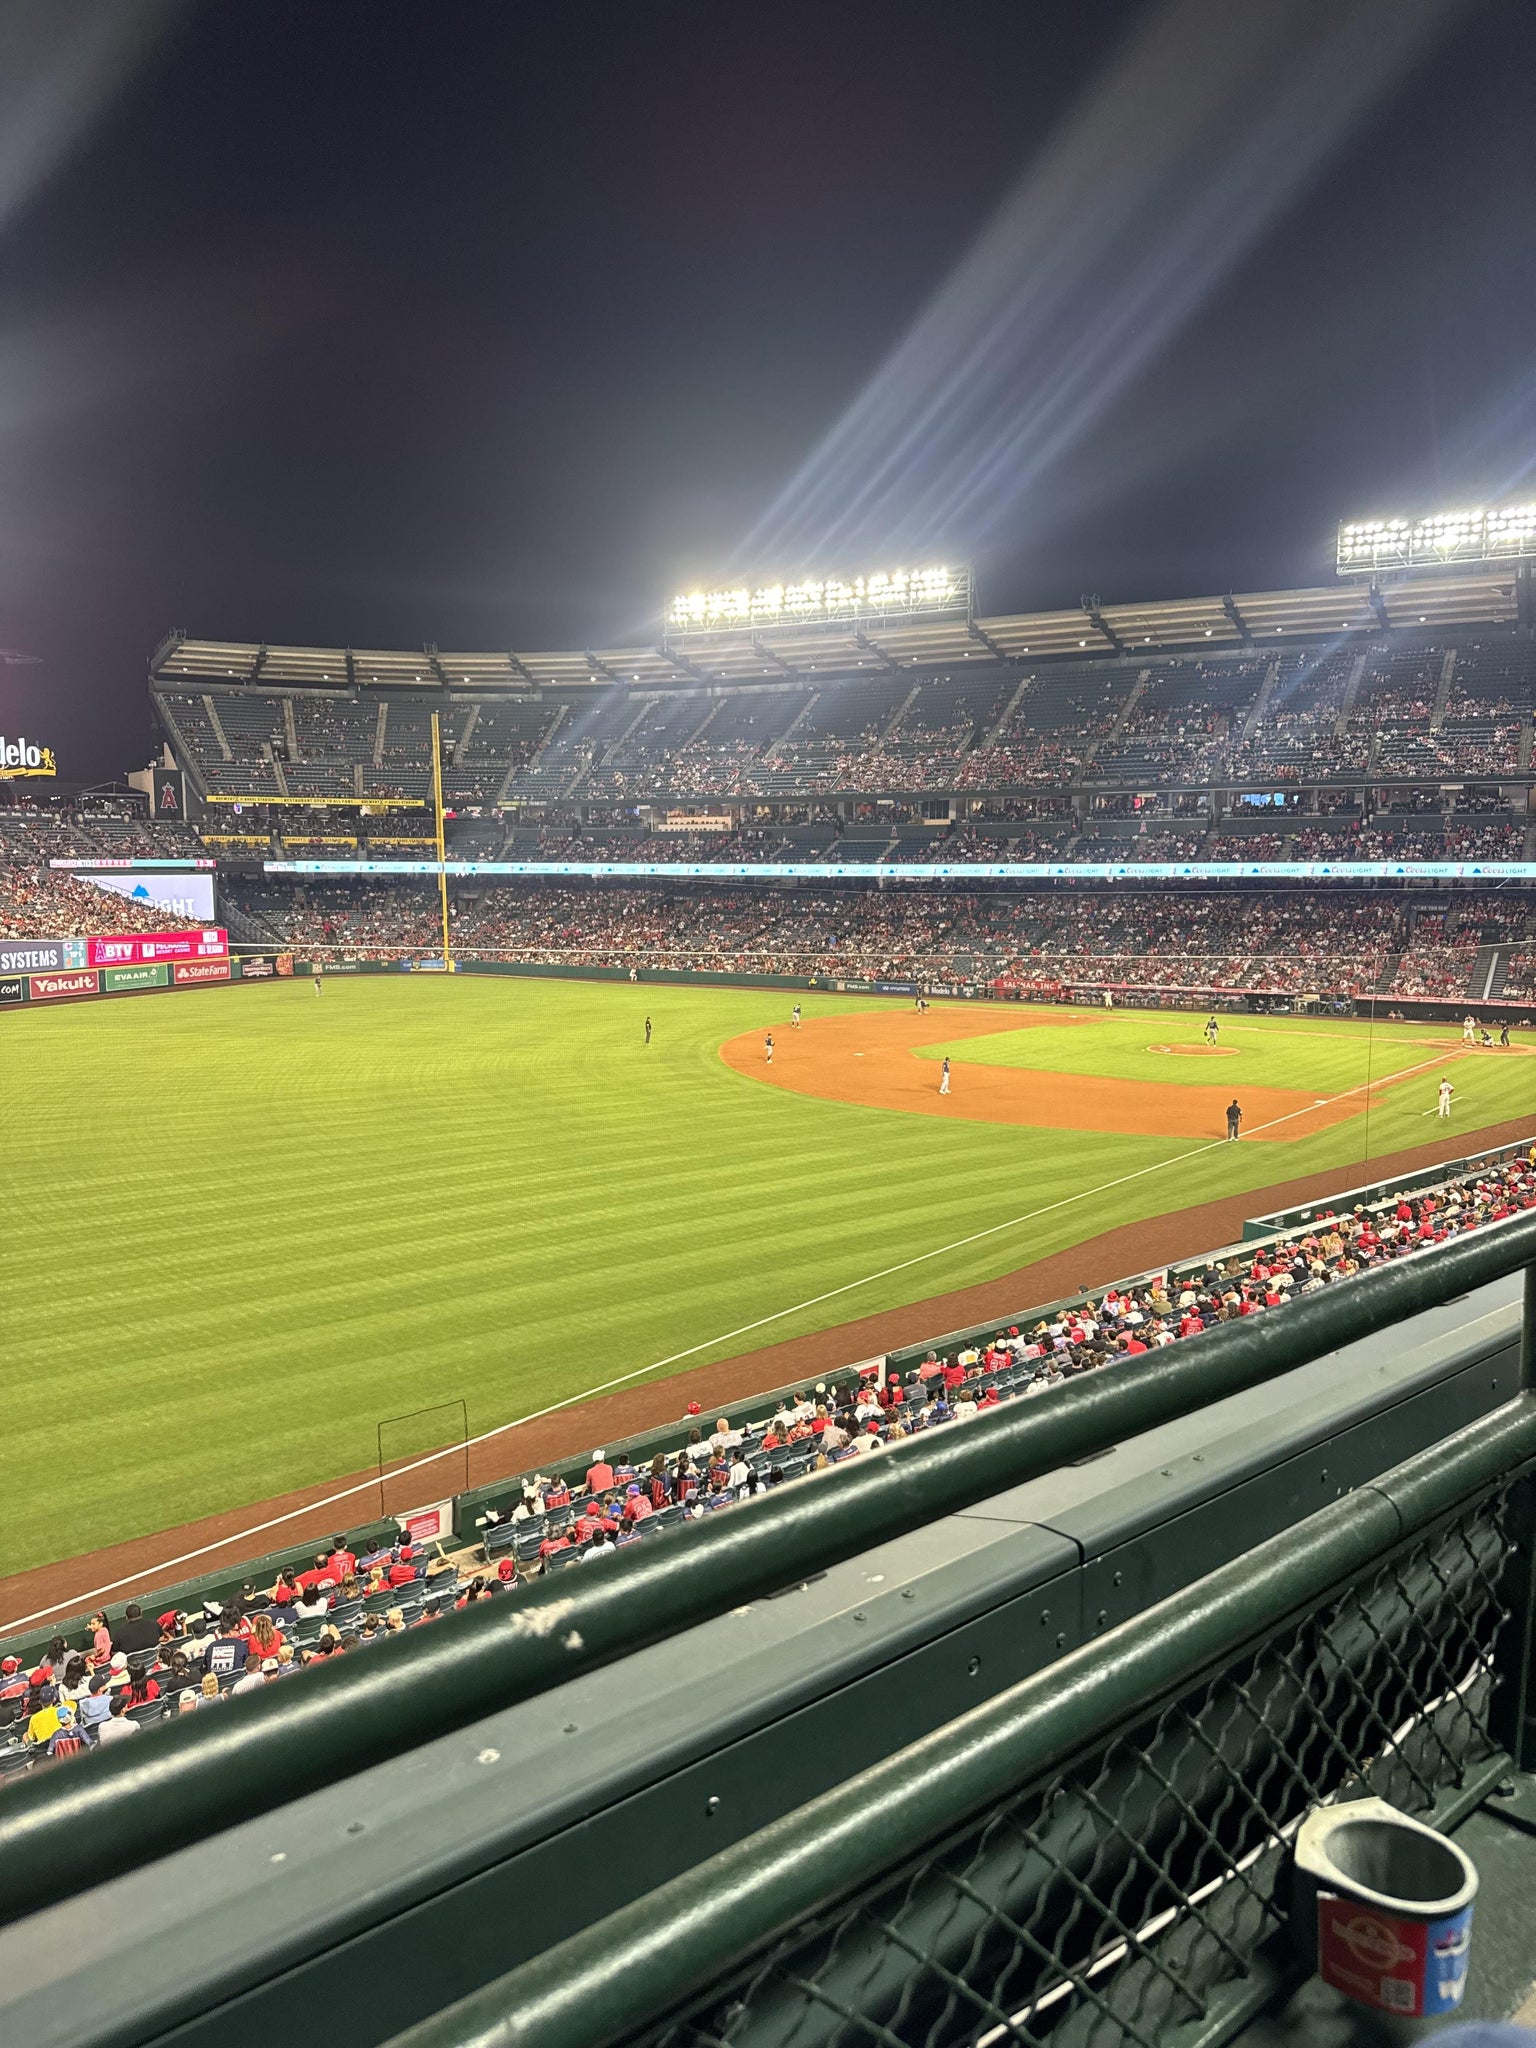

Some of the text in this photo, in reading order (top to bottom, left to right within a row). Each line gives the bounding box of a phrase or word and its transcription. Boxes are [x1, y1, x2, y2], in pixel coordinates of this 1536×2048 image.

[148, 898, 195, 916] IGHT
[0, 949, 58, 970] SYSTEMS
[34, 975, 95, 993] Yakult
